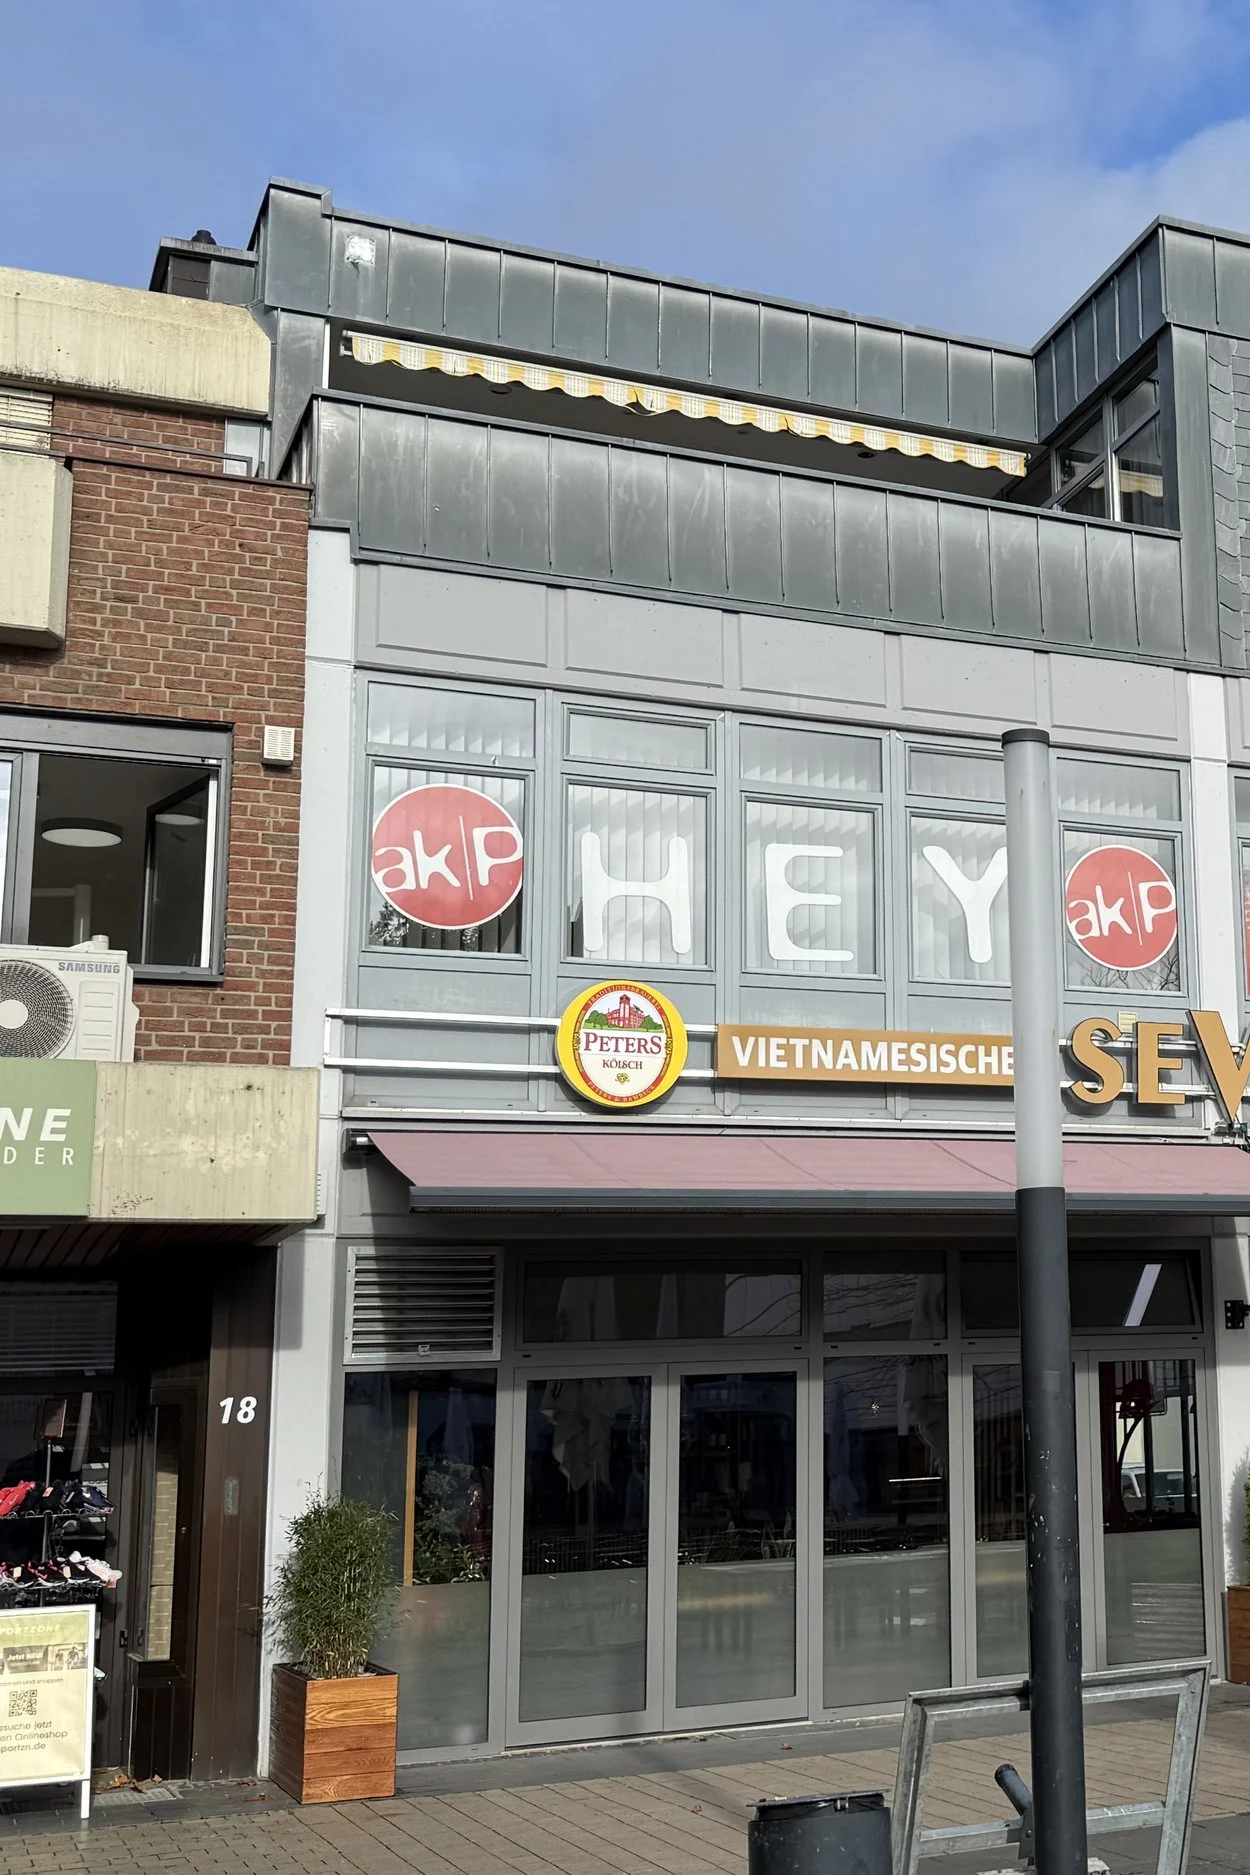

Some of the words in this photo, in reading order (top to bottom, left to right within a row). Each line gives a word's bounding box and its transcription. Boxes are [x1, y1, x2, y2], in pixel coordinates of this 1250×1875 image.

[58, 961, 121, 974] SAMSUNG
[583, 1031, 662, 1055] PETERS
[602, 1058, 643, 1070] KÖLSCH
[219, 1396, 258, 1424] 18
